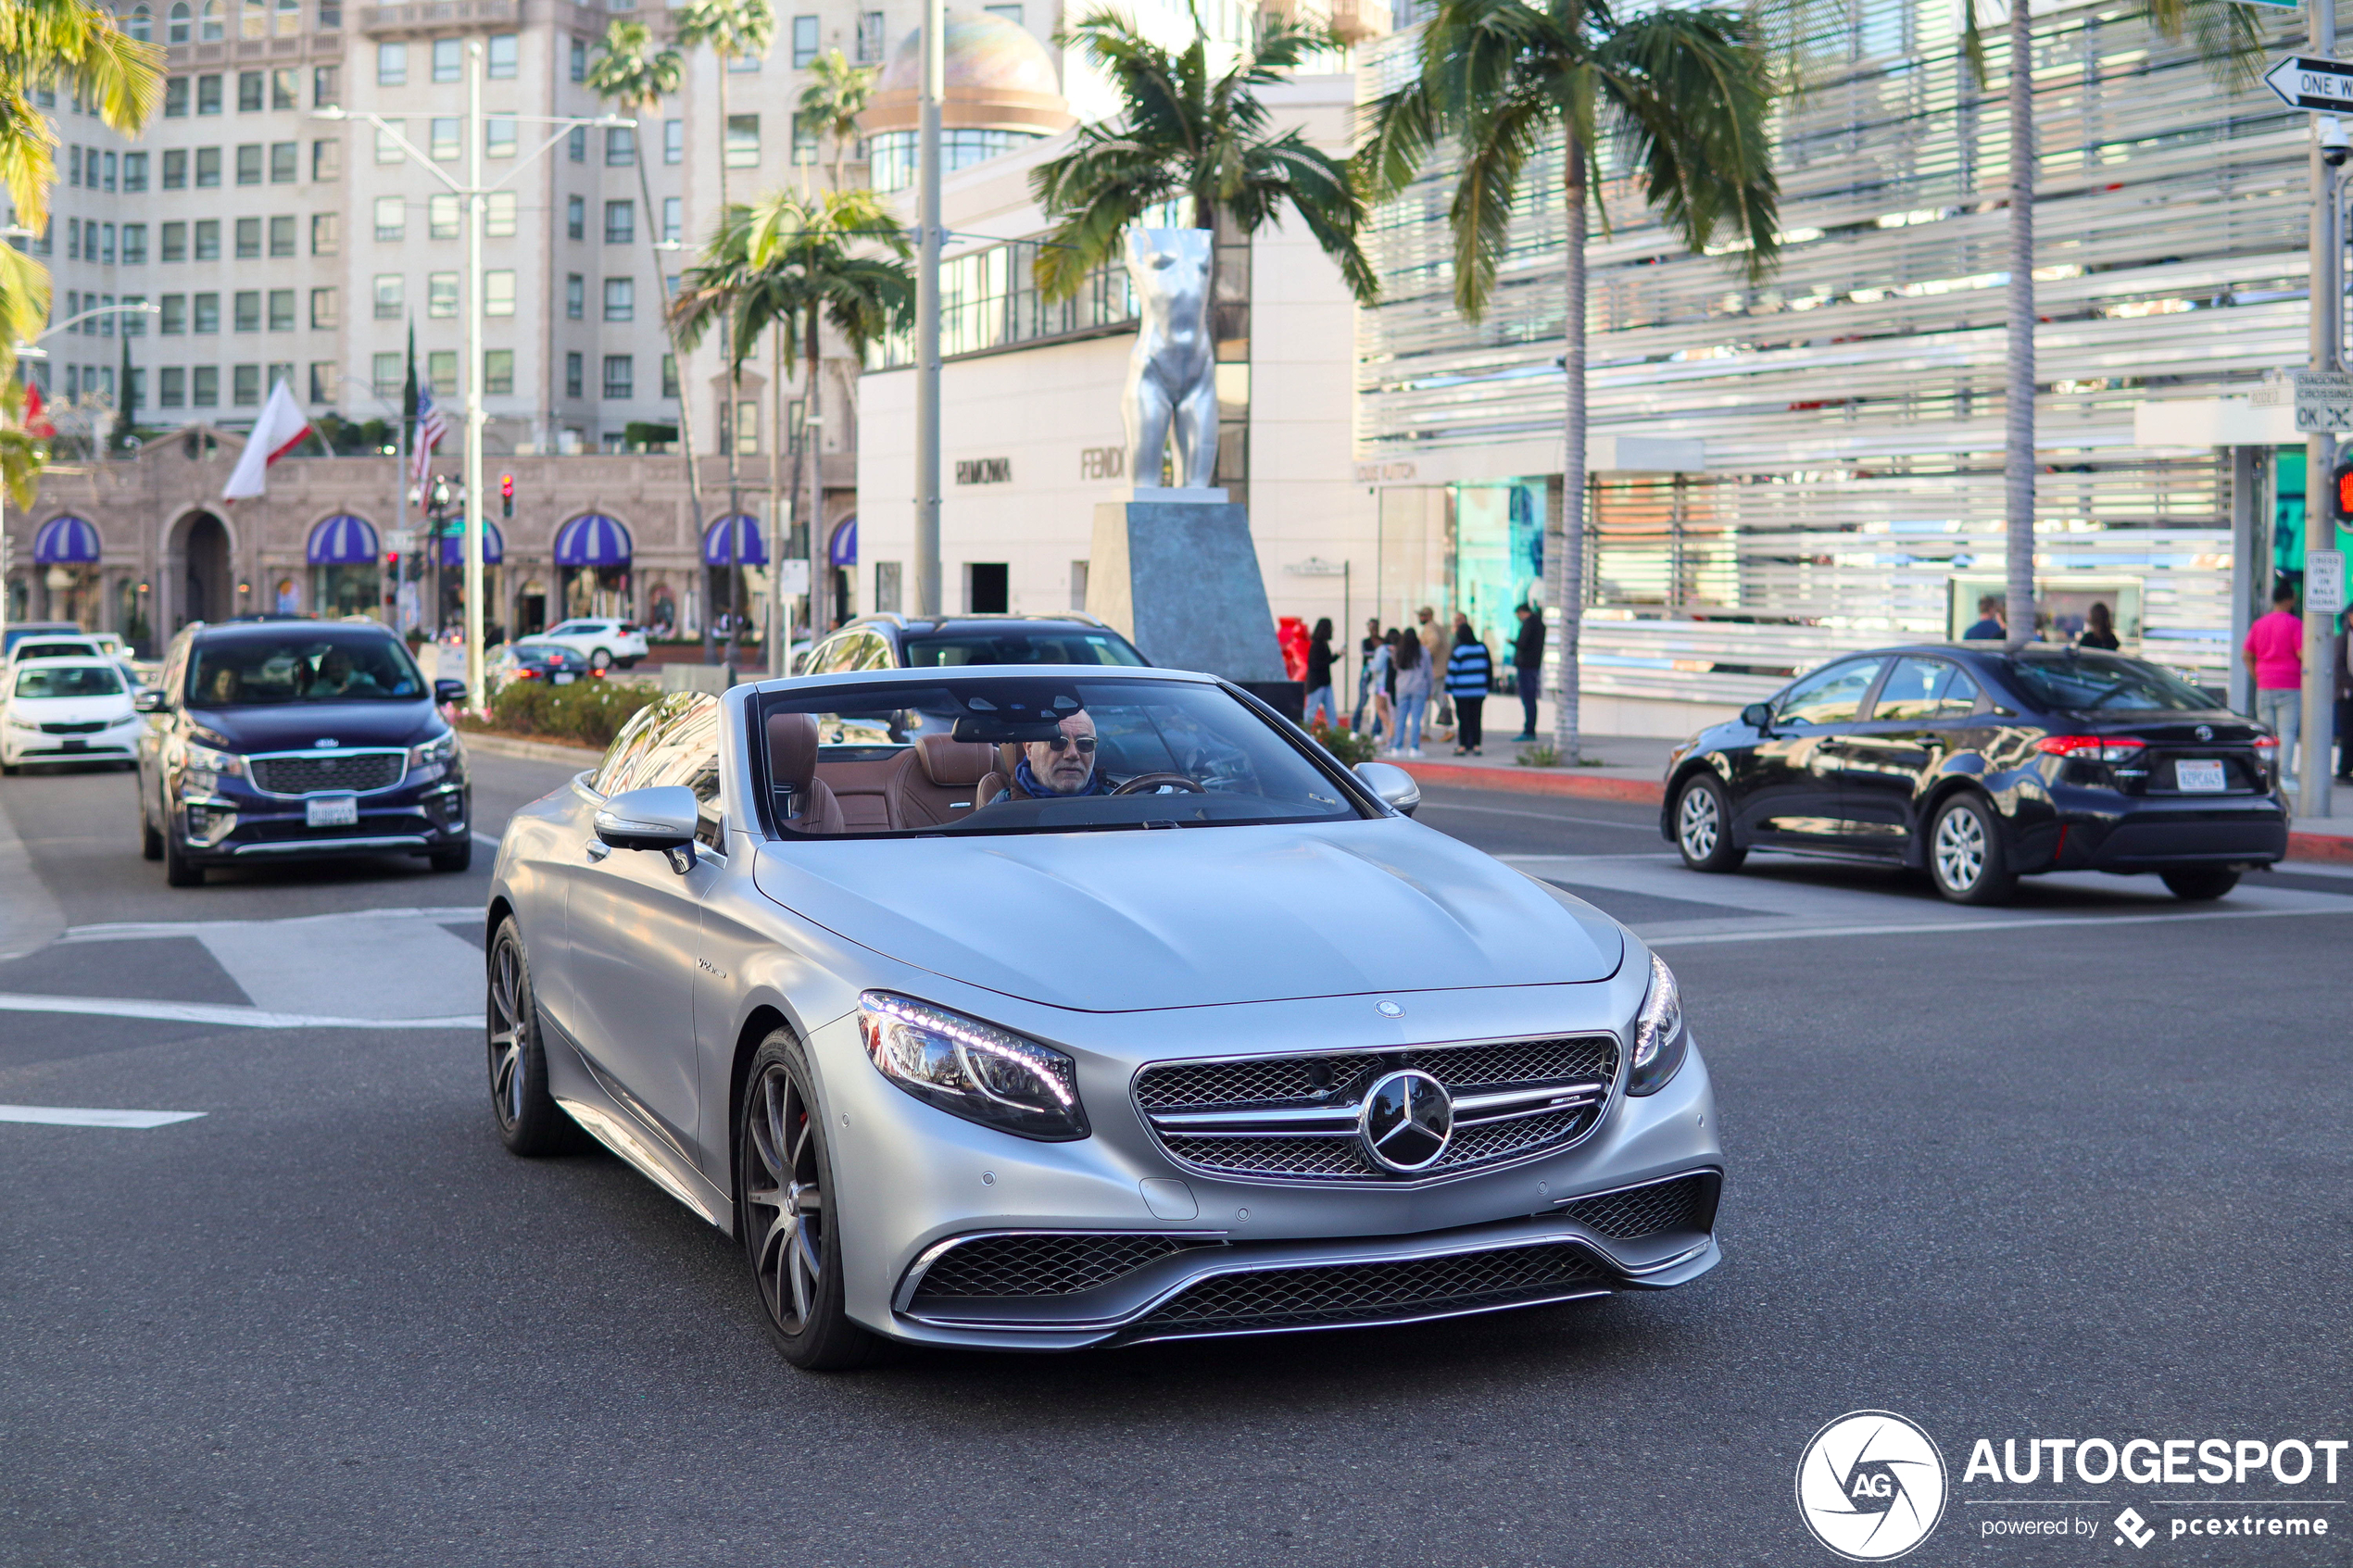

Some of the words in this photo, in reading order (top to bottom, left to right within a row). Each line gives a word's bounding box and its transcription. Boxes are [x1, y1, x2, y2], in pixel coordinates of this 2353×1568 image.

[2301, 74, 2334, 94] ONE
[2297, 373, 2350, 384] DIAGONAL
[2297, 408, 2318, 426] OK
[956, 458, 1012, 484] RIMOWA
